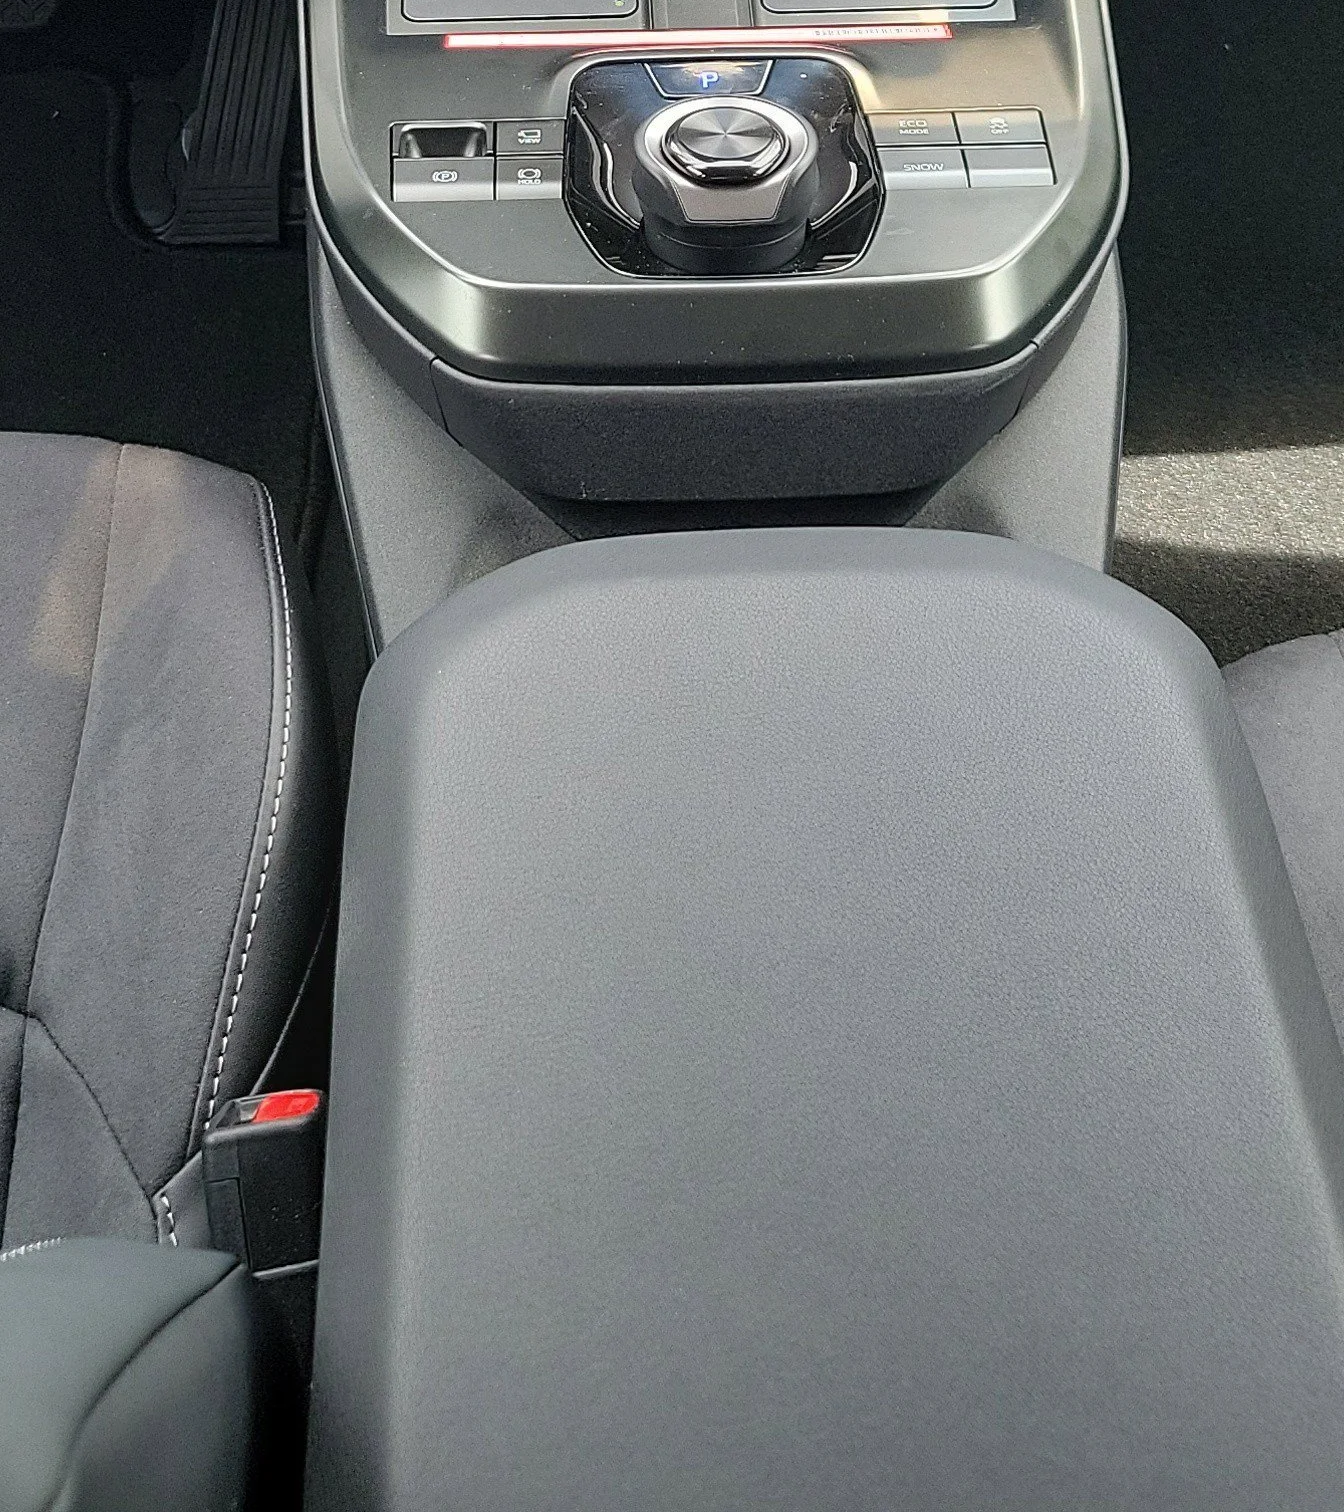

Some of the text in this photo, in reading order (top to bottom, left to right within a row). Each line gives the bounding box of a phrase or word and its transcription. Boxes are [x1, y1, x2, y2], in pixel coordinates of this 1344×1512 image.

[701, 71, 719, 88] P
[898, 119, 928, 127] ECO
[903, 162, 945, 172] SNOW
